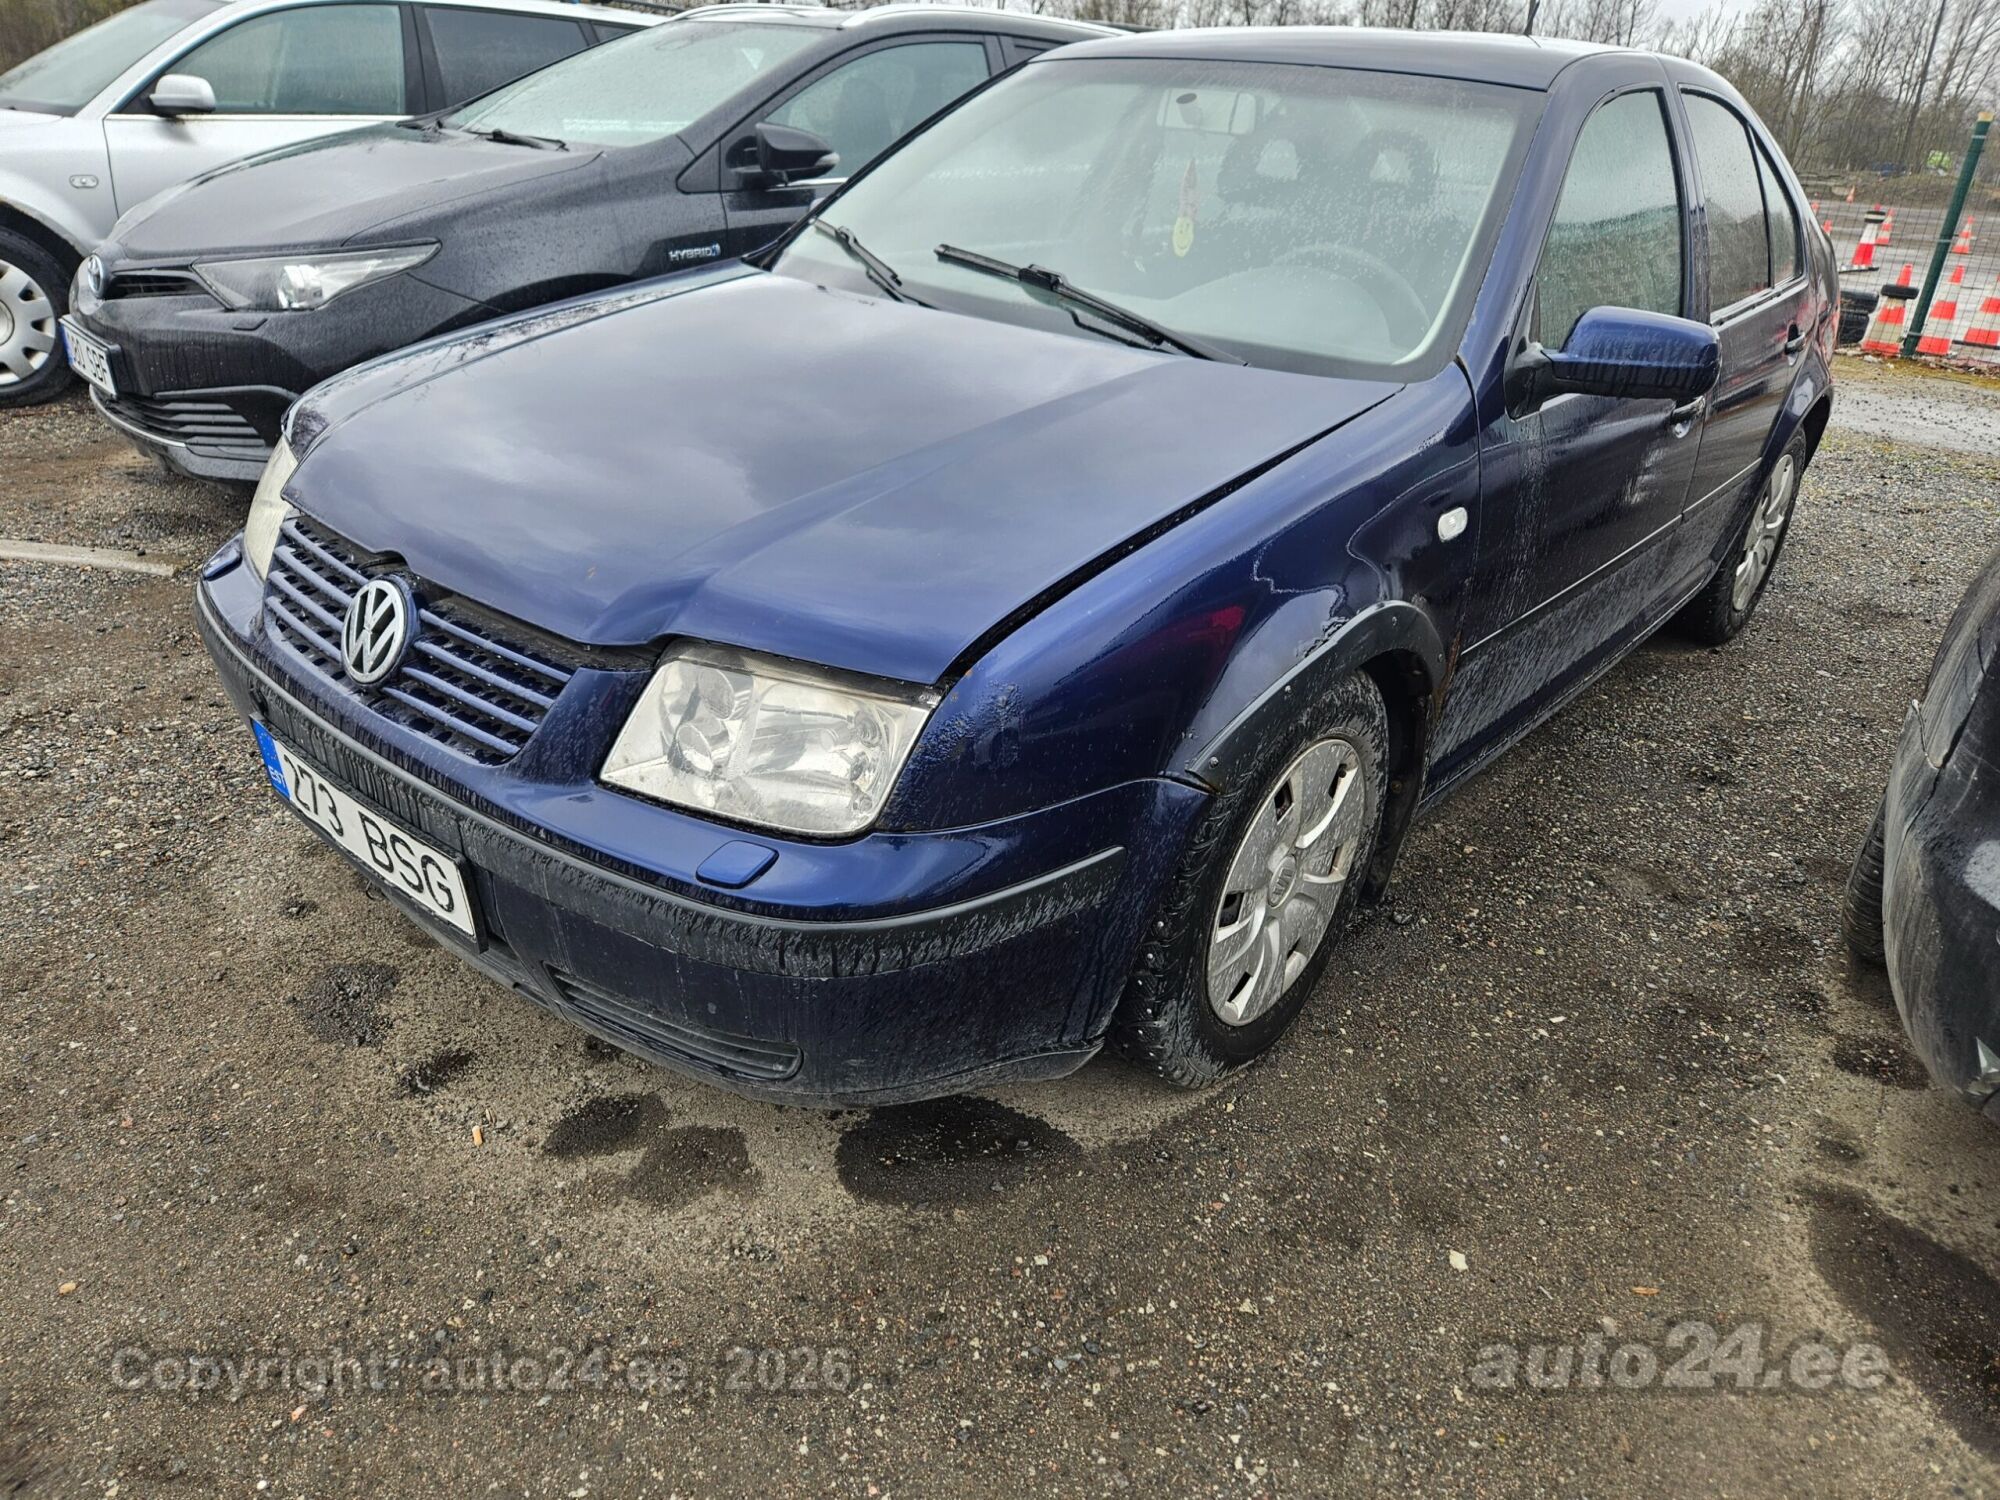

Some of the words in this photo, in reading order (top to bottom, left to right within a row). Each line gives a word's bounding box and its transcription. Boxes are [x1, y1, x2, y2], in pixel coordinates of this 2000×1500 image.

[668, 246, 713, 261] HYBRID
[268, 765, 286, 788] EST
[283, 754, 344, 837] 273
[358, 810, 454, 913] BSG
